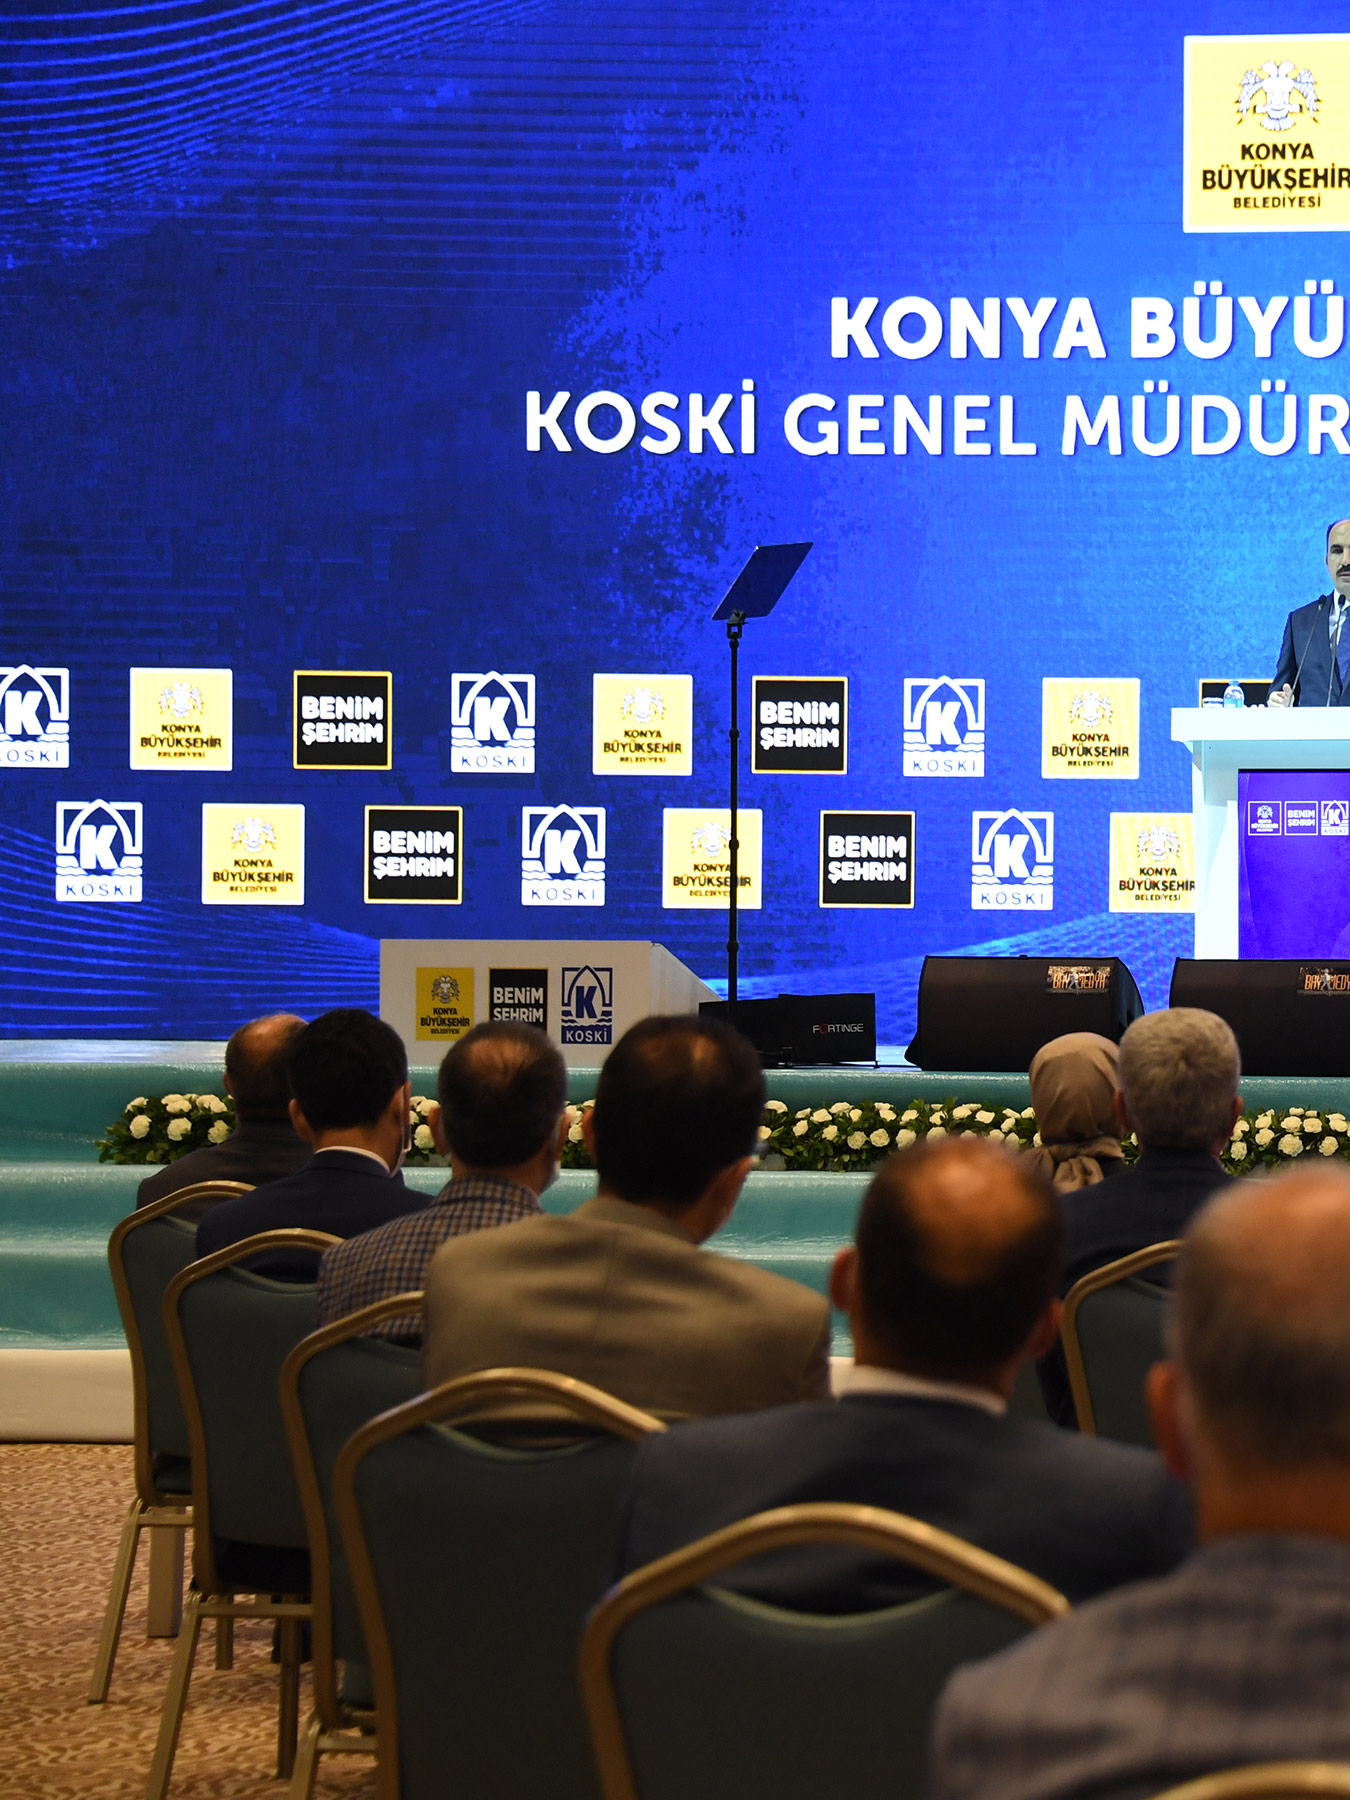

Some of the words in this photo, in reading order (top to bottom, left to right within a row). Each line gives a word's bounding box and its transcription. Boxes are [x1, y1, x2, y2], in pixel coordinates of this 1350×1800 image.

[1241, 143, 1315, 160] KONYA
[1233, 193, 1321, 209] BELEDİYESİ
[832, 296, 1106, 359] KONYA
[527, 379, 754, 454] KOSKİ
[784, 393, 1036, 455] GENEL
[162, 725, 200, 735] KONYA
[624, 730, 662, 738] KONYA
[1072, 734, 1109, 743] KONYA
[234, 859, 272, 867] KONYA
[1140, 867, 1177, 876] KONYA
[673, 873, 751, 888] BÜYÜKŞEİR
[493, 987, 544, 1004] BENİM
[566, 1028, 608, 1042] KOSKİ
[812, 1023, 864, 1035] FORTINGE
